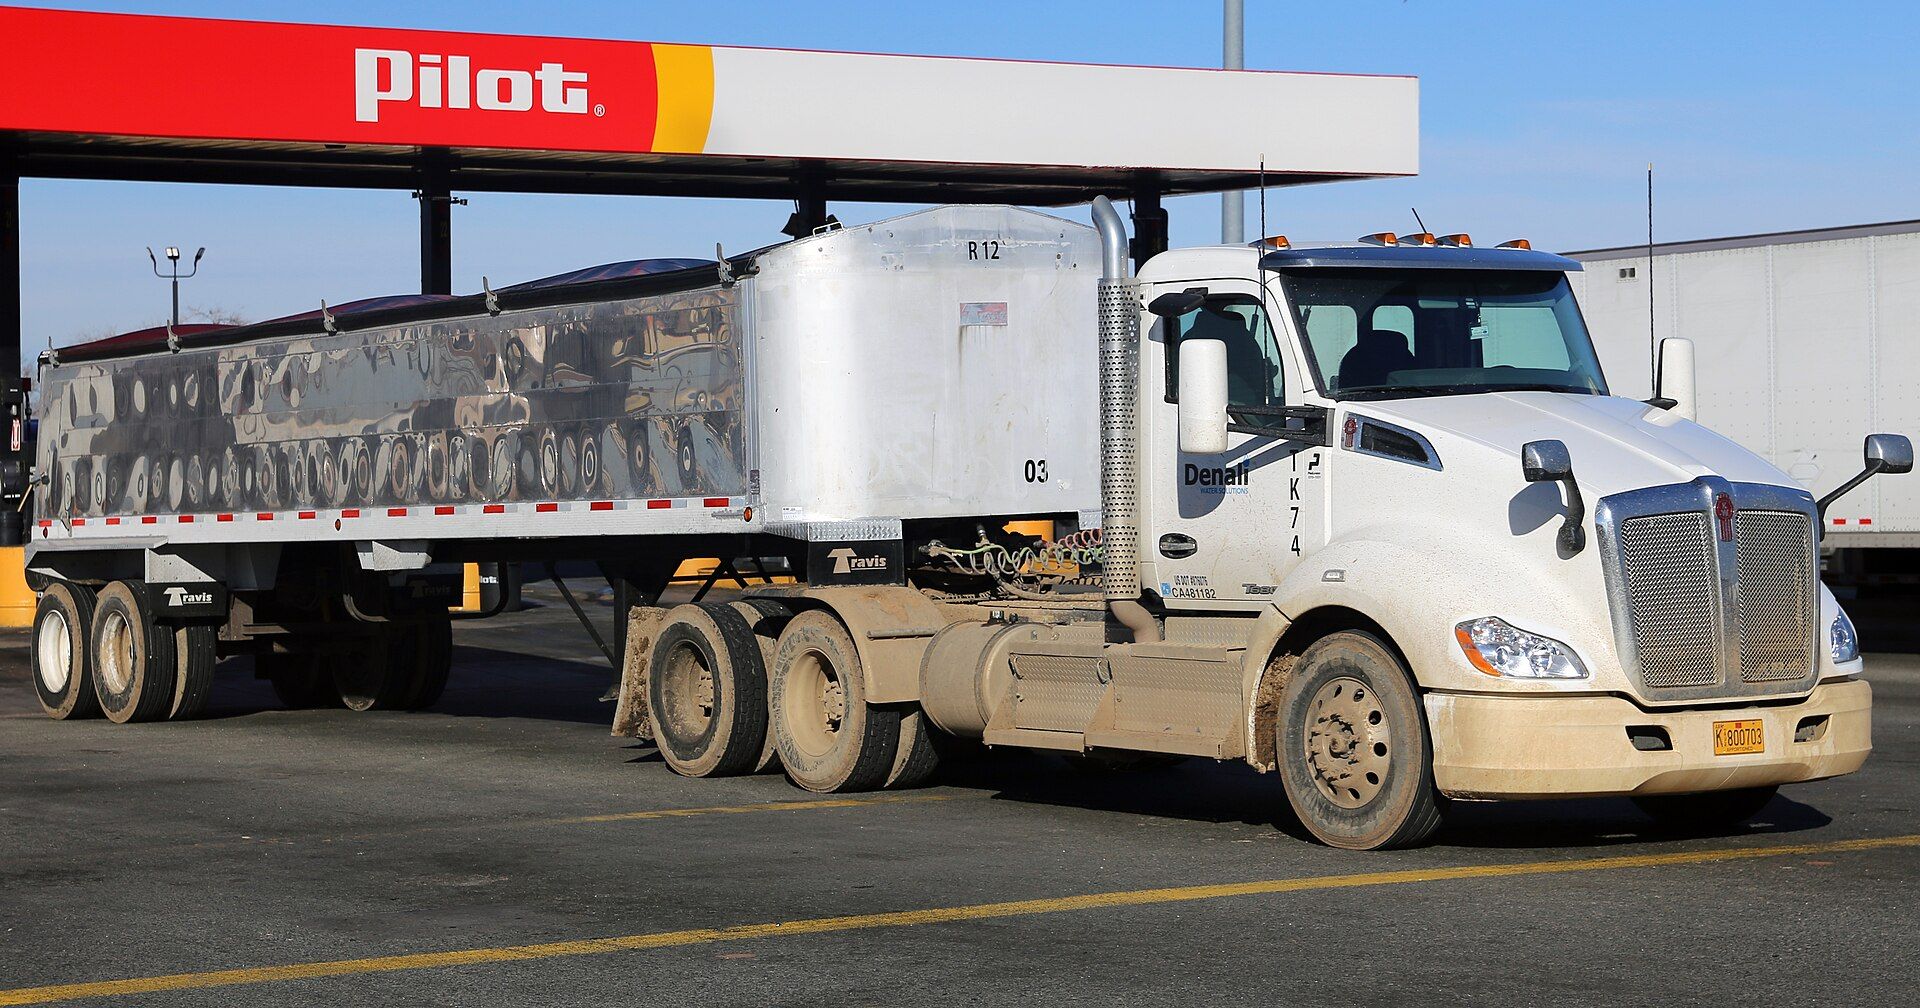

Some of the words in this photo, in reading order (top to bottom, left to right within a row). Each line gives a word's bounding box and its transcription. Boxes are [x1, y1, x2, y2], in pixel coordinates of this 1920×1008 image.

[355, 48, 588, 122] Pilot
[968, 241, 978, 260] R
[982, 241, 1000, 260] 12
[1024, 459, 1049, 483] 03
[1185, 460, 1250, 486] Denali
[1219, 487, 1249, 495] SOLUTIONS
[827, 547, 887, 574] Travis
[163, 586, 212, 606] Travis
[1171, 587, 1217, 599] CA481182
[1727, 728, 1762, 746] 800703
